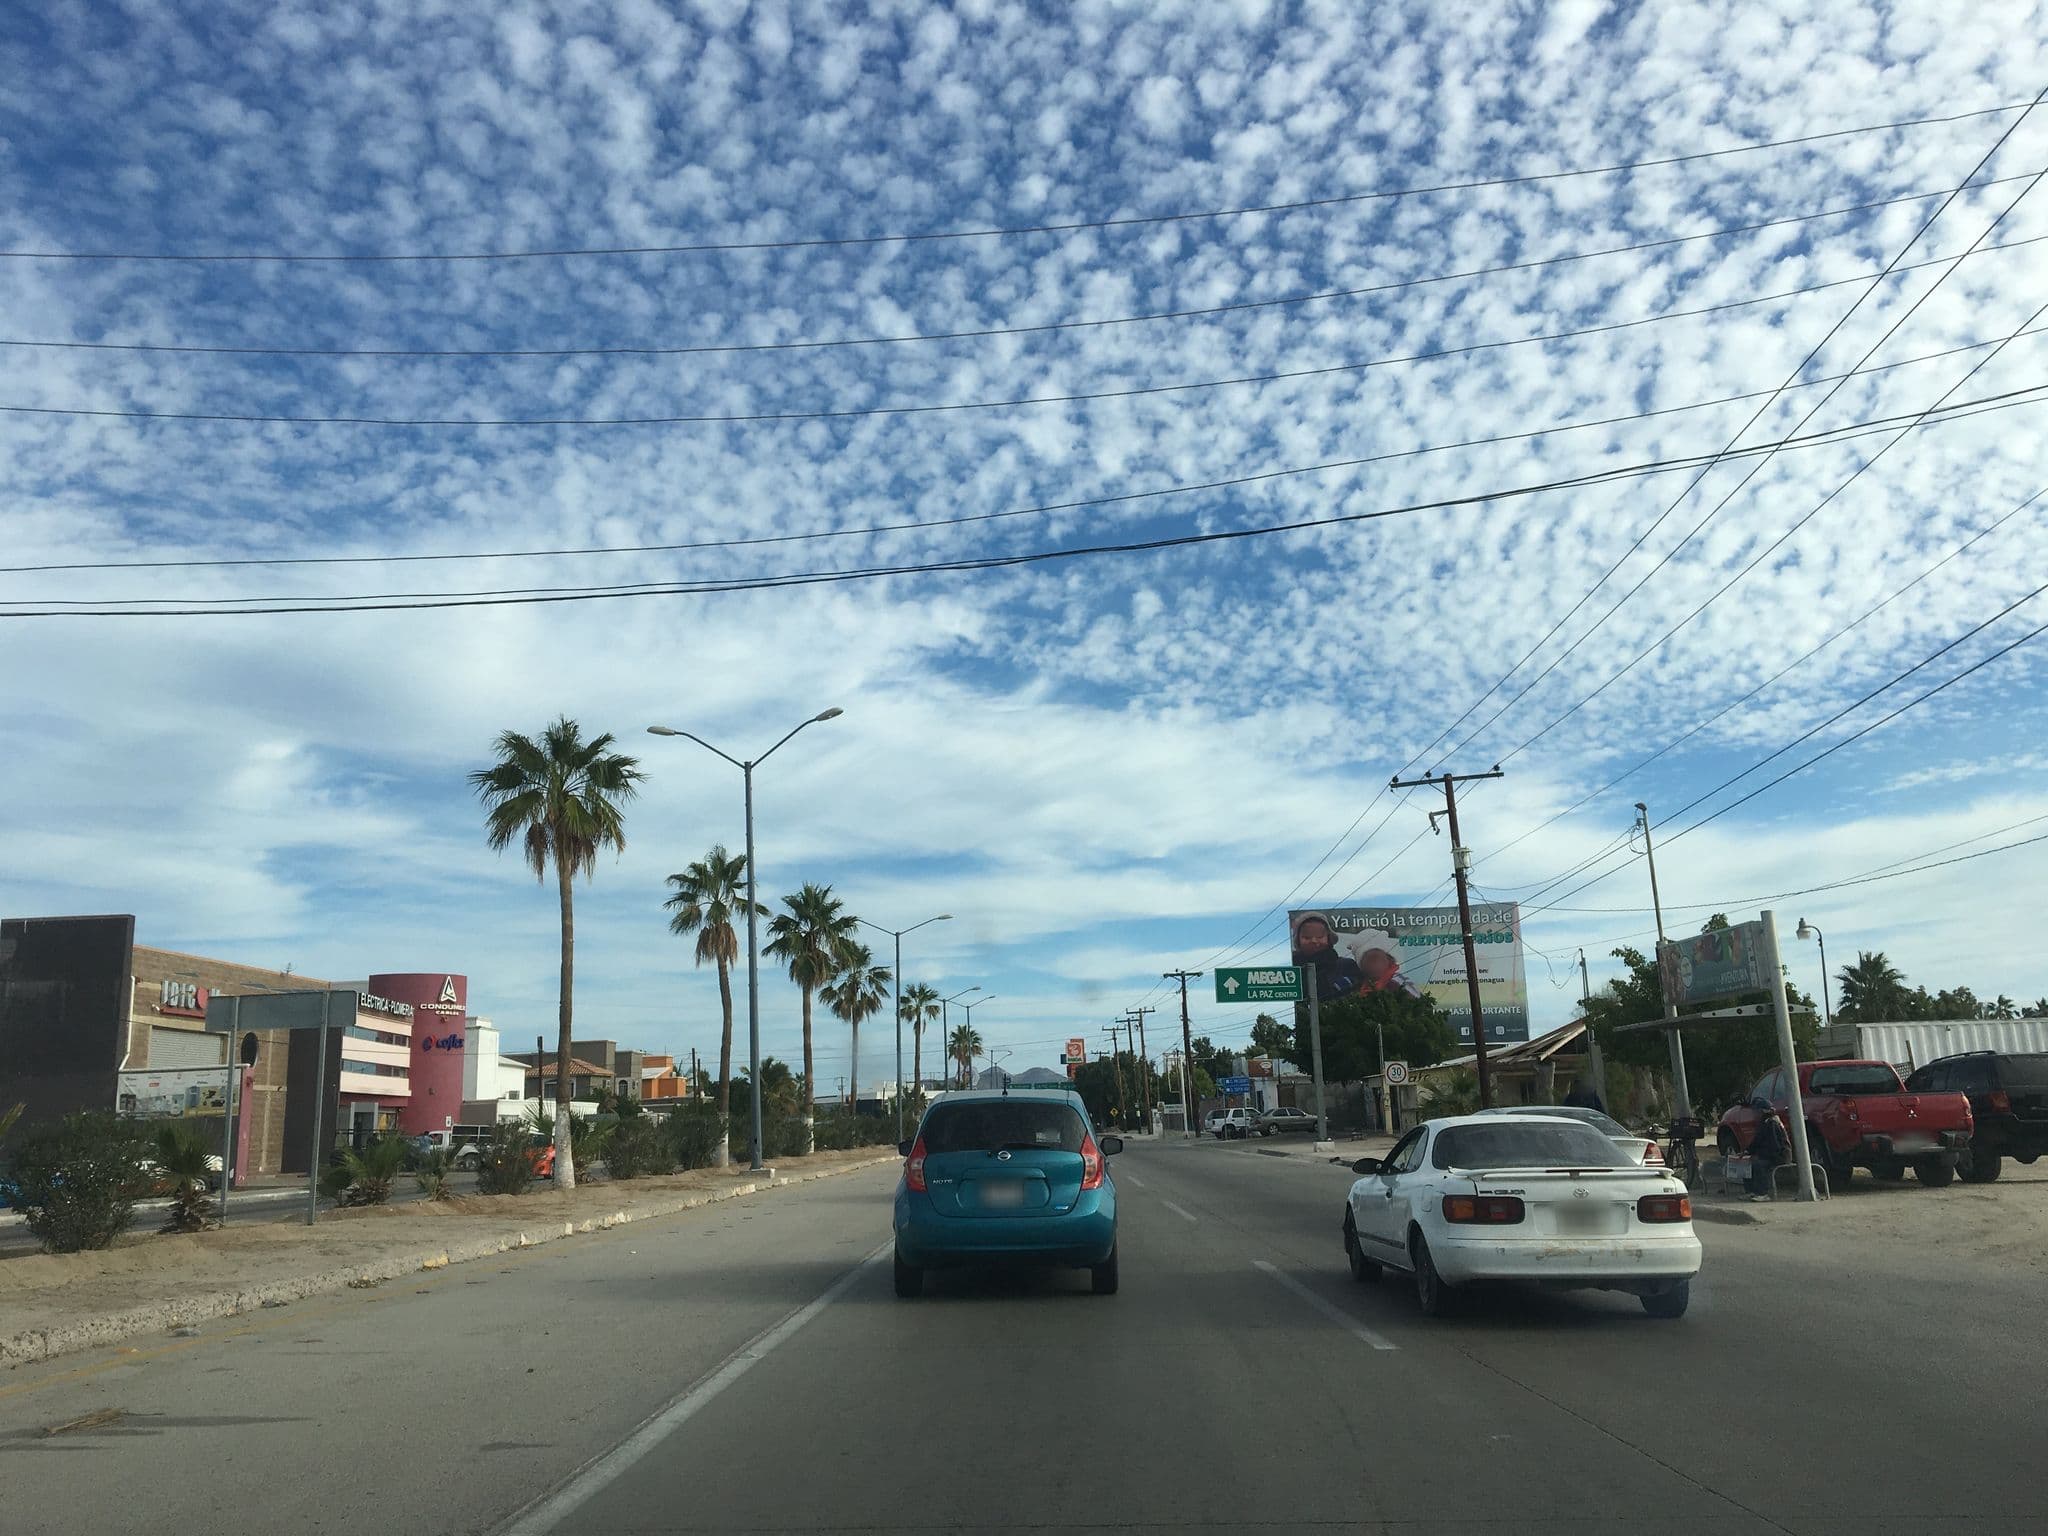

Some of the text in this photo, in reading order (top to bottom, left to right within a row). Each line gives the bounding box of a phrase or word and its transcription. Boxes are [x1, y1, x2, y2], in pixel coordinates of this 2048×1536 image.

[1331, 915, 1350, 928] Ya
[1353, 912, 1389, 928] inició
[1393, 913, 1405, 926] la
[1494, 910, 1512, 923] de
[1247, 971, 1284, 984] MEGA
[1247, 990, 1258, 998] LA
[1260, 990, 1273, 998] PAZ
[1391, 1067, 1402, 1076] 30
